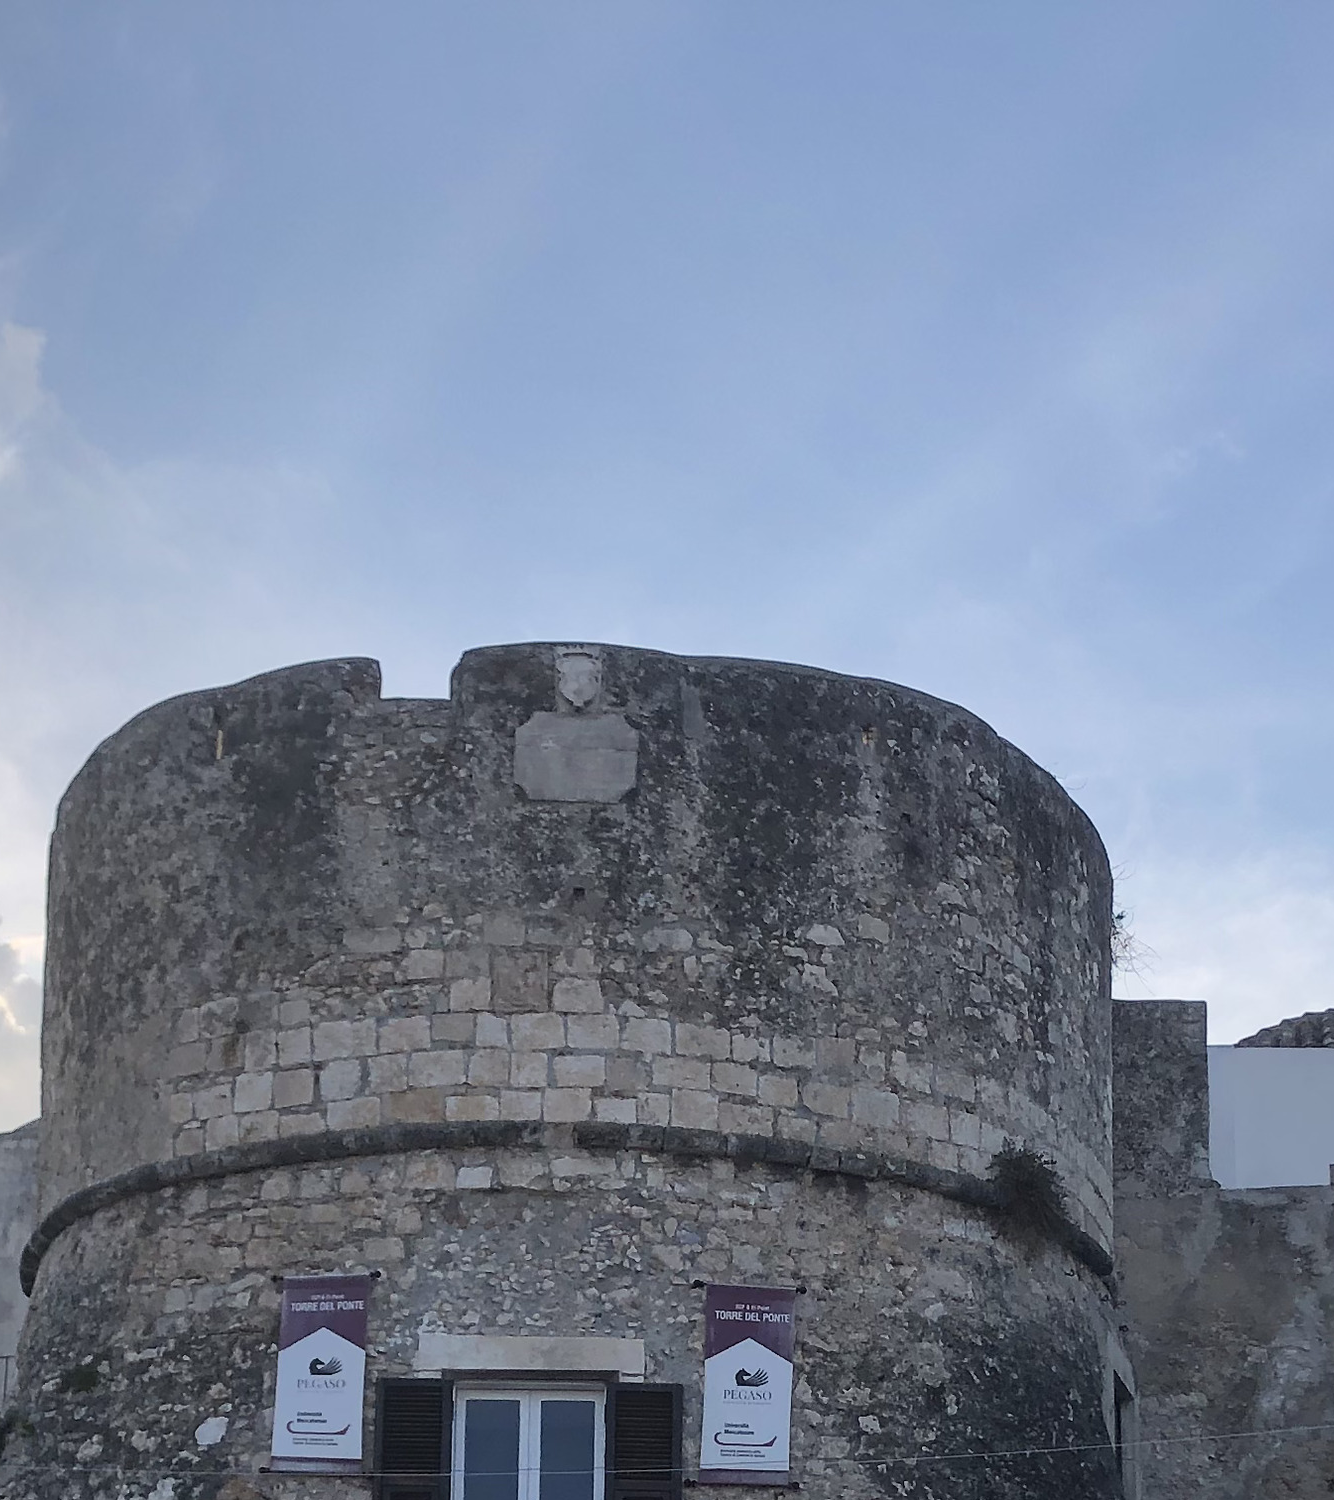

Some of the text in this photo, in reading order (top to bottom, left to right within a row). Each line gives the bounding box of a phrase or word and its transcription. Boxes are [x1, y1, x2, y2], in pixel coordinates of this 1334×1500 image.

[291, 1300, 364, 1312] TORRE DEL PONTE
[715, 1310, 790, 1323] TORRE DEL PONTE
[297, 1378, 346, 1390] PEGASO
[723, 1389, 772, 1401] PEGASO
